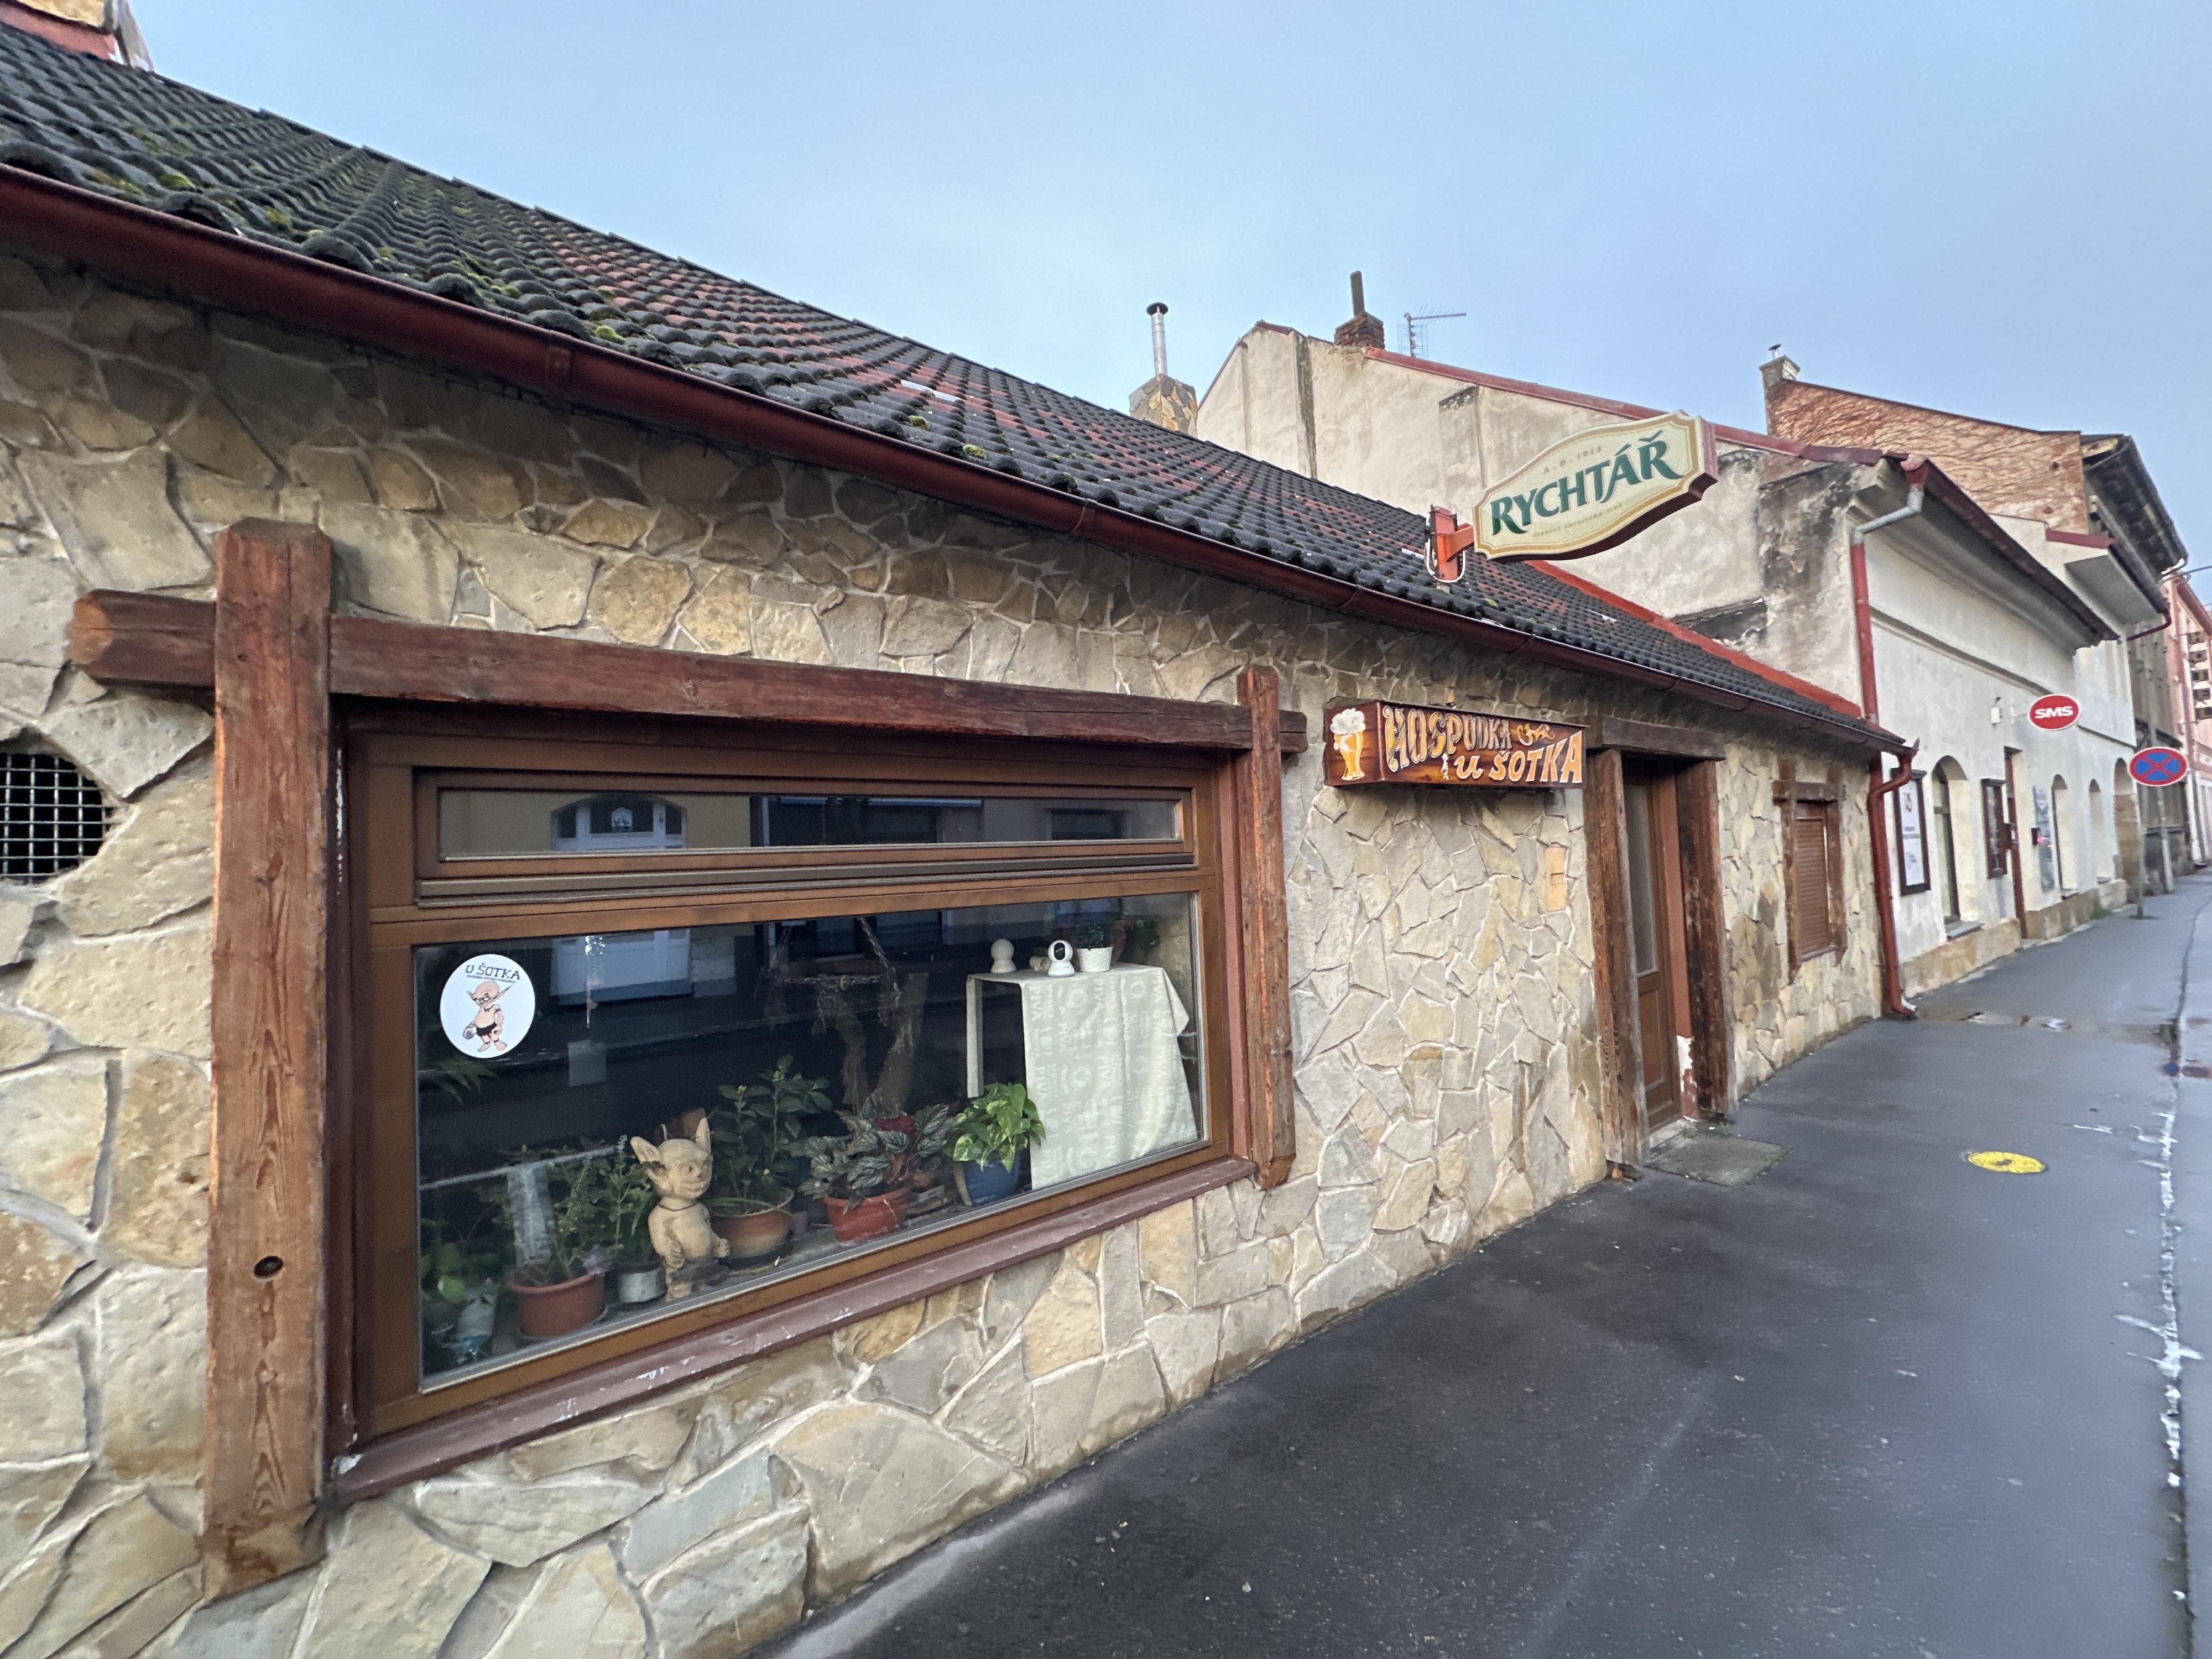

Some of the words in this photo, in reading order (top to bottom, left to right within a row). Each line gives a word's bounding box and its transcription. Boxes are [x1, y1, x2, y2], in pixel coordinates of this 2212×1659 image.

[1490, 430, 1685, 536] RYCHTÁŘ
[1383, 705, 1512, 772] HOSPŮDKA
[2034, 706, 2074, 719] SMS
[1489, 730, 1583, 784] ŠOTKA
[465, 964, 474, 973] U
[476, 963, 520, 980] ŠOTKA
